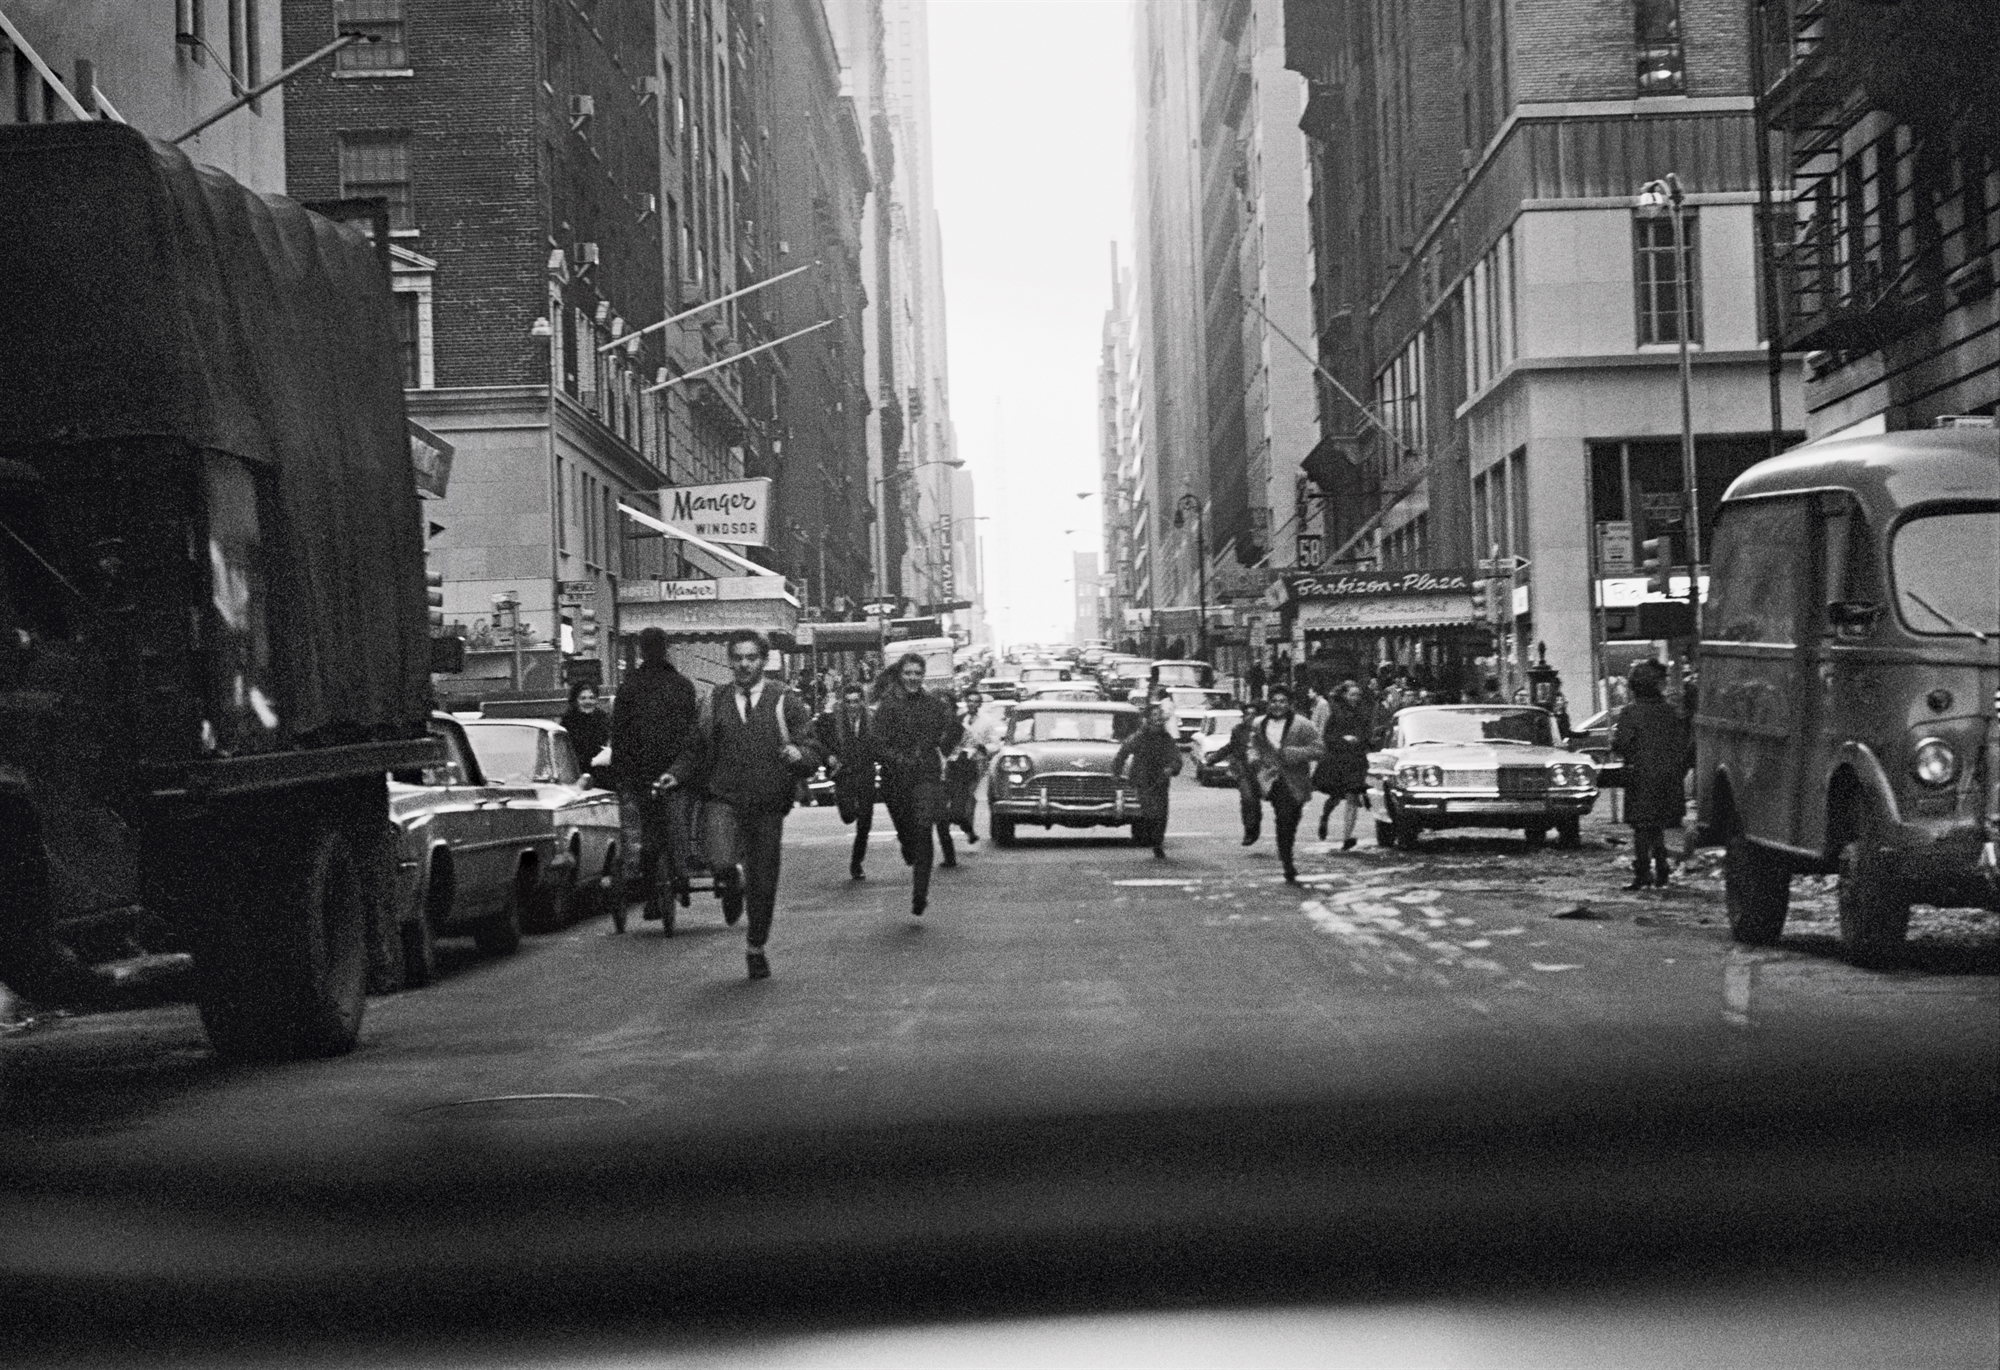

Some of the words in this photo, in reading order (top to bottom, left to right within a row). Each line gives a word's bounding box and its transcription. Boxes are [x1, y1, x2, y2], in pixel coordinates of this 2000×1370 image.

[671, 491, 756, 521] Manger
[695, 522, 758, 535] WINDSOR
[1299, 539, 1321, 567] 58
[665, 582, 714, 600] Manger
[1293, 573, 1467, 596] Barbizon-Plaza
